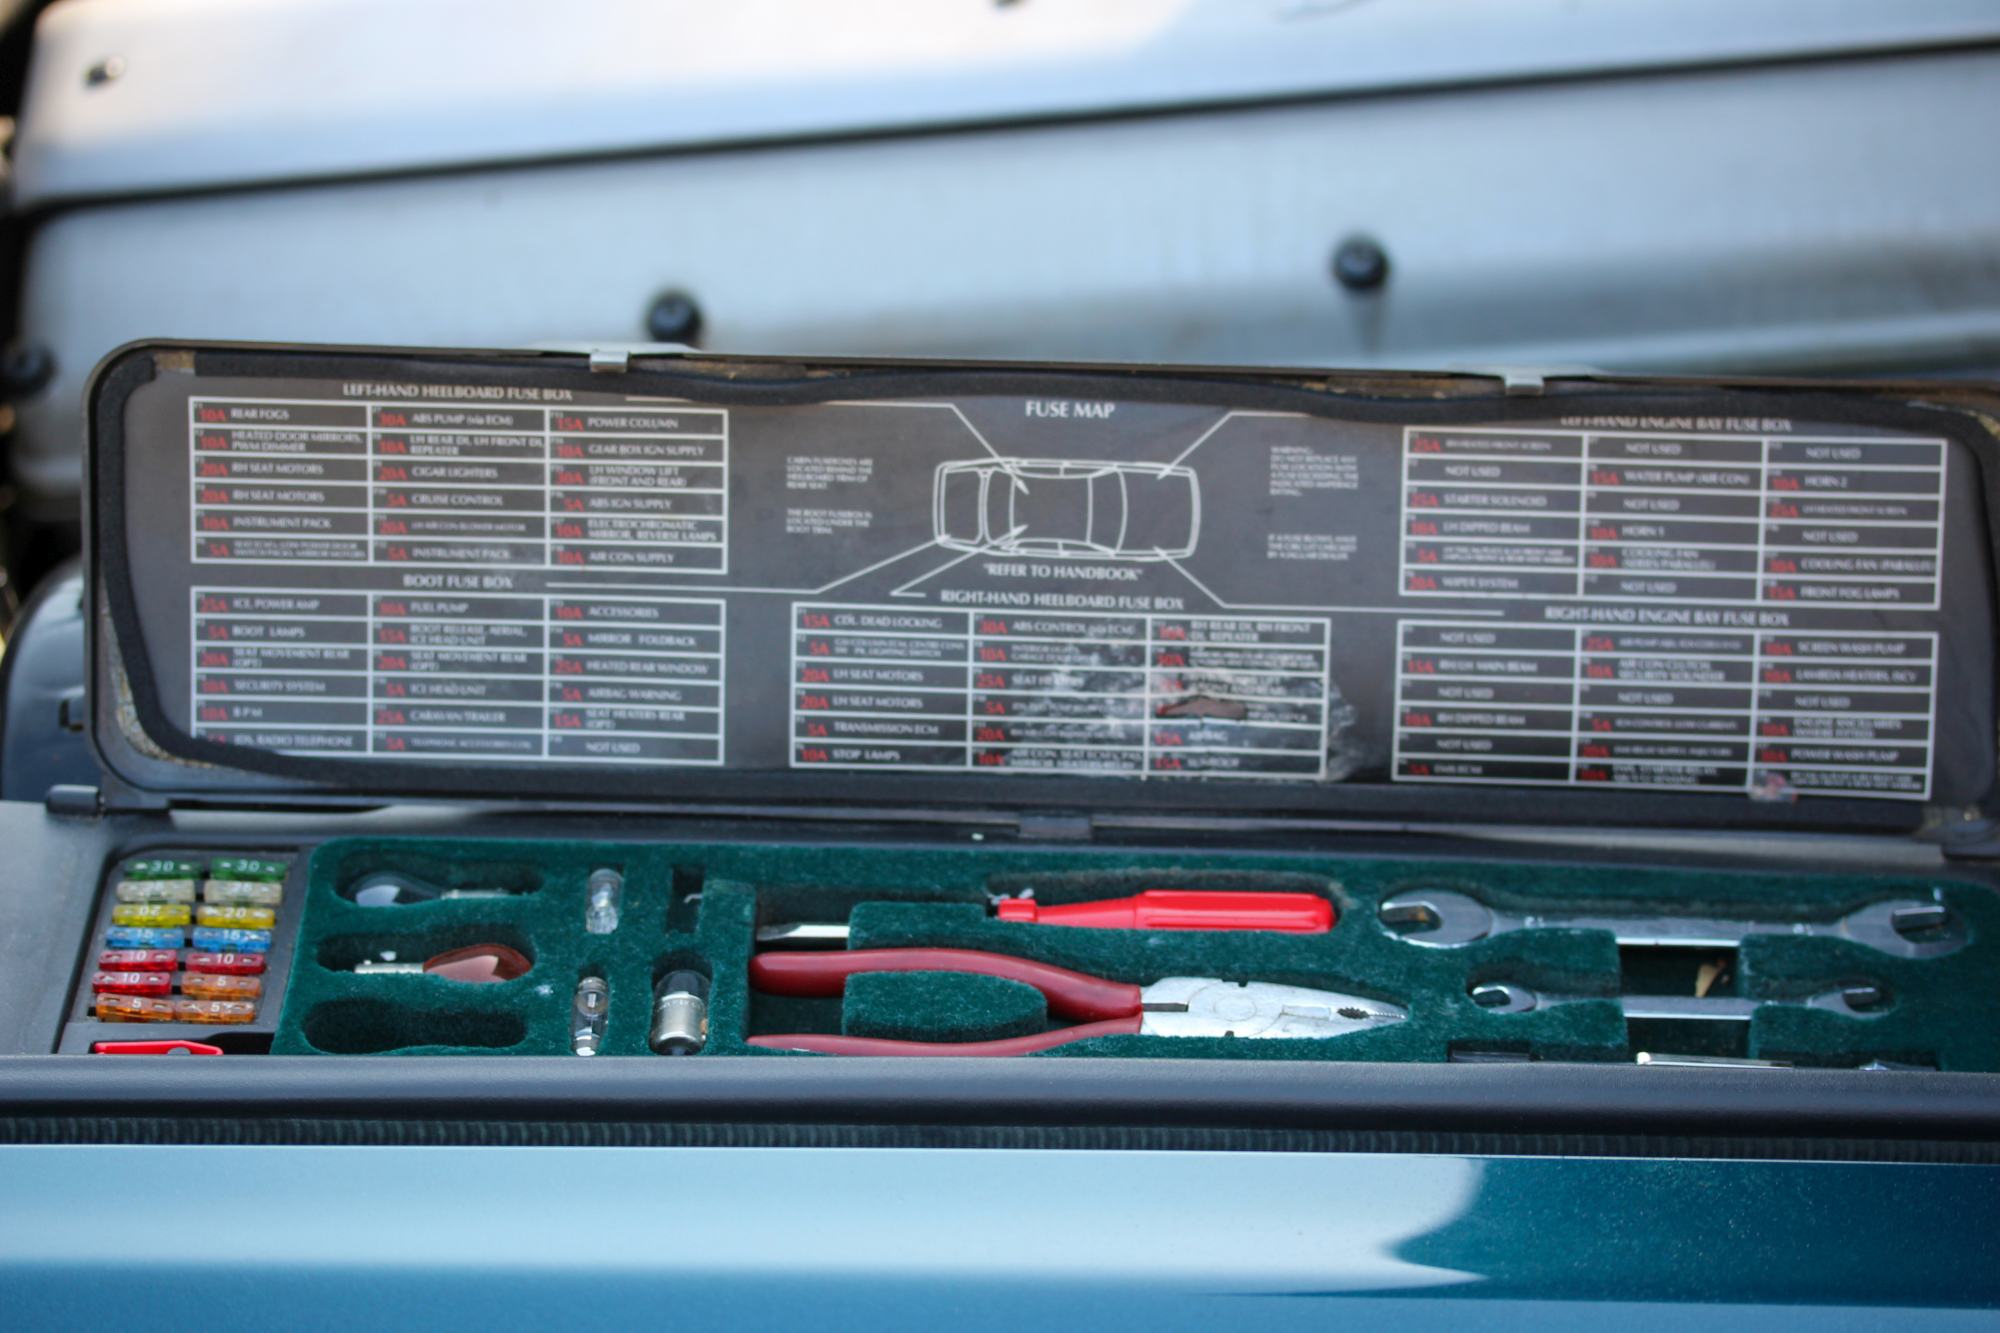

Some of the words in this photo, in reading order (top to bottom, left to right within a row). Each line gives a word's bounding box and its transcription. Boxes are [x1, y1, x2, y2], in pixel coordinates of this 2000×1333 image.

[343, 384, 418, 396] LEFT-HAND
[422, 386, 504, 398] HEELBOARD
[507, 388, 540, 399] FUSE
[543, 389, 574, 400] BOX
[231, 409, 257, 419] REAR
[258, 410, 289, 420] FOGS
[1025, 401, 1069, 417] FUSE
[1074, 403, 1115, 418] MAP
[434, 414, 465, 424] PUMP
[588, 417, 627, 427] POWER
[629, 418, 678, 428] COLUMN
[1697, 419, 1722, 429] BAY
[1726, 419, 1759, 430] FUSE
[1761, 419, 1792, 431] BOX
[427, 435, 454, 445] REAR
[589, 444, 618, 454] GEAR
[666, 445, 704, 456] SUPPLY
[1652, 444, 1682, 455] USED
[1832, 449, 1861, 459] USED
[250, 464, 274, 473] SEAT
[276, 464, 323, 475] MOTORS
[412, 466, 445, 477] CIGAR
[448, 467, 498, 478] LIGHTERS
[604, 466, 656, 475] WINDOW
[1445, 466, 1470, 475] NOT
[1472, 467, 1501, 477] USED
[632, 477, 655, 486] AND
[1624, 471, 1662, 481] WATER
[1664, 472, 1694, 482] PUMP
[251, 491, 274, 500] SEAT
[276, 491, 324, 502] MOTORS
[451, 495, 503, 505] CONTROL
[634, 499, 672, 509] SUPPLY
[1650, 500, 1679, 510] USED
[233, 517, 297, 528] INSTRUMENT
[299, 519, 331, 529] PACK
[682, 531, 717, 541] LAMPS
[1622, 526, 1657, 536] HORN
[1829, 532, 1858, 543] USED
[482, 549, 510, 559] PACK
[589, 551, 607, 561] AIR
[609, 552, 634, 562] CON
[637, 552, 674, 563] SUPPLY
[1031, 565, 1050, 577] TO
[403, 575, 443, 587] BOOT
[448, 576, 479, 587] FUSE
[483, 577, 513, 588] BOX
[1648, 583, 1677, 593] USED
[941, 591, 1030, 604] RIGHT-HAND
[1034, 593, 1116, 607] HEELBOARD
[1119, 595, 1151, 608] FUSE
[1155, 598, 1184, 609] BOX
[588, 607, 659, 618] ACCESSORIES
[893, 616, 942, 628] LOCKING
[1694, 611, 1720, 624] BAY
[1723, 612, 1755, 625] FUSE
[1759, 613, 1789, 626] BOX
[232, 627, 264, 636] BOOT
[1012, 622, 1032, 631] ABS
[1035, 623, 1085, 632] CONTROL
[1467, 633, 1495, 643] USED
[586, 661, 627, 671] HEATED
[630, 662, 656, 671] REAR
[850, 670, 873, 679] SEAT
[877, 670, 923, 681] MOTORS
[1464, 688, 1494, 699] USED
[1644, 693, 1673, 704] USED
[850, 696, 873, 706] SEAT
[876, 697, 922, 708] MOTORS
[1821, 697, 1850, 708] USED
[834, 722, 913, 732] TRANSMISSION
[915, 724, 939, 734] ECM
[586, 742, 610, 752] NOT
[612, 743, 640, 753] USED
[1463, 740, 1492, 750] USED
[832, 750, 861, 759] STOP
[865, 750, 900, 760] LAMPS
[151, 861, 174, 872] 30
[237, 860, 259, 872] 30
[225, 908, 246, 918] 20
[128, 950, 147, 960] 10
[216, 954, 234, 964] 10
[122, 973, 140, 983] 10
[217, 977, 226, 987] 5
[132, 999, 142, 1008] 5
[211, 1002, 220, 1012] 5
